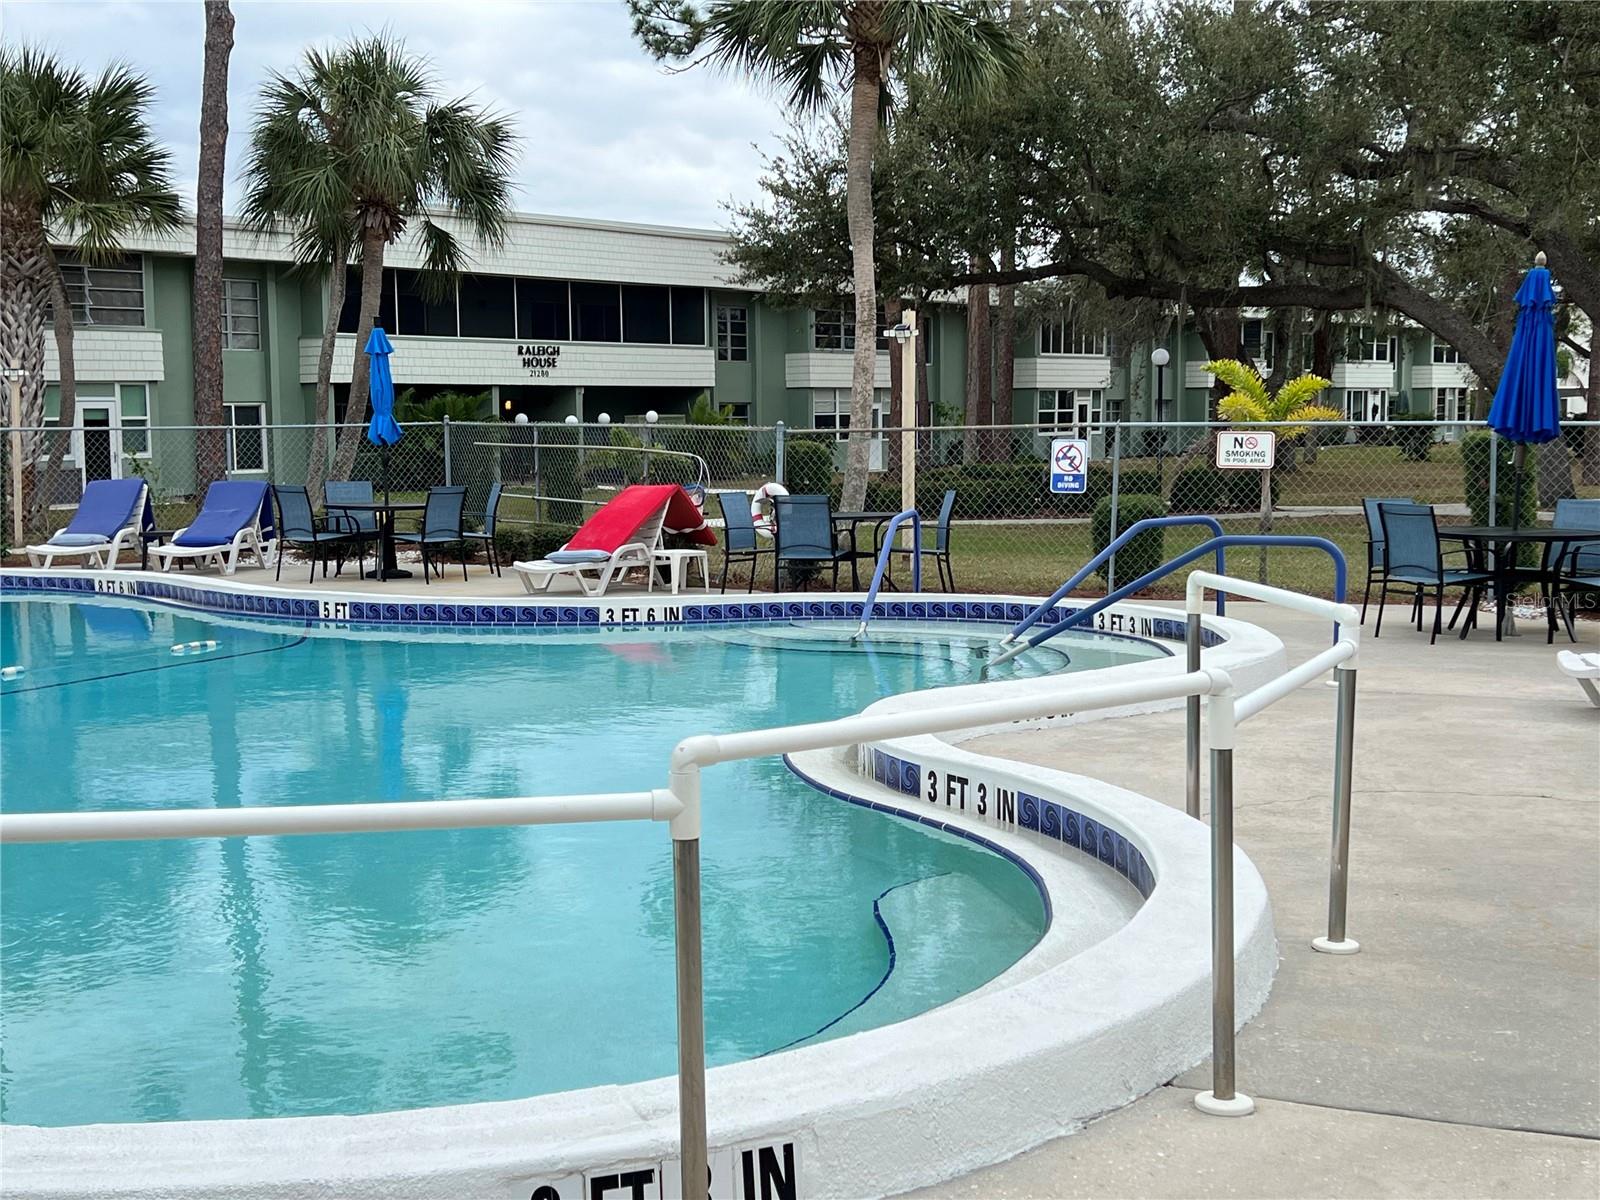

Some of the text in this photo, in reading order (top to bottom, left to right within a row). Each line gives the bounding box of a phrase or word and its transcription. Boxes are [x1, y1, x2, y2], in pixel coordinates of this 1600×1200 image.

[517, 345, 560, 356] RALEIGH
[522, 357, 558, 368] HOUSE
[106, 580, 116, 593] FT
[119, 581, 125, 594] 6
[127, 581, 136, 595] IN
[323, 601, 348, 619] 5 FT
[606, 607, 680, 622] 3 FT 6 IN
[1098, 612, 1152, 637] 3 FT 3 IN
[927, 770, 1015, 825] 3 FT 3 IN
